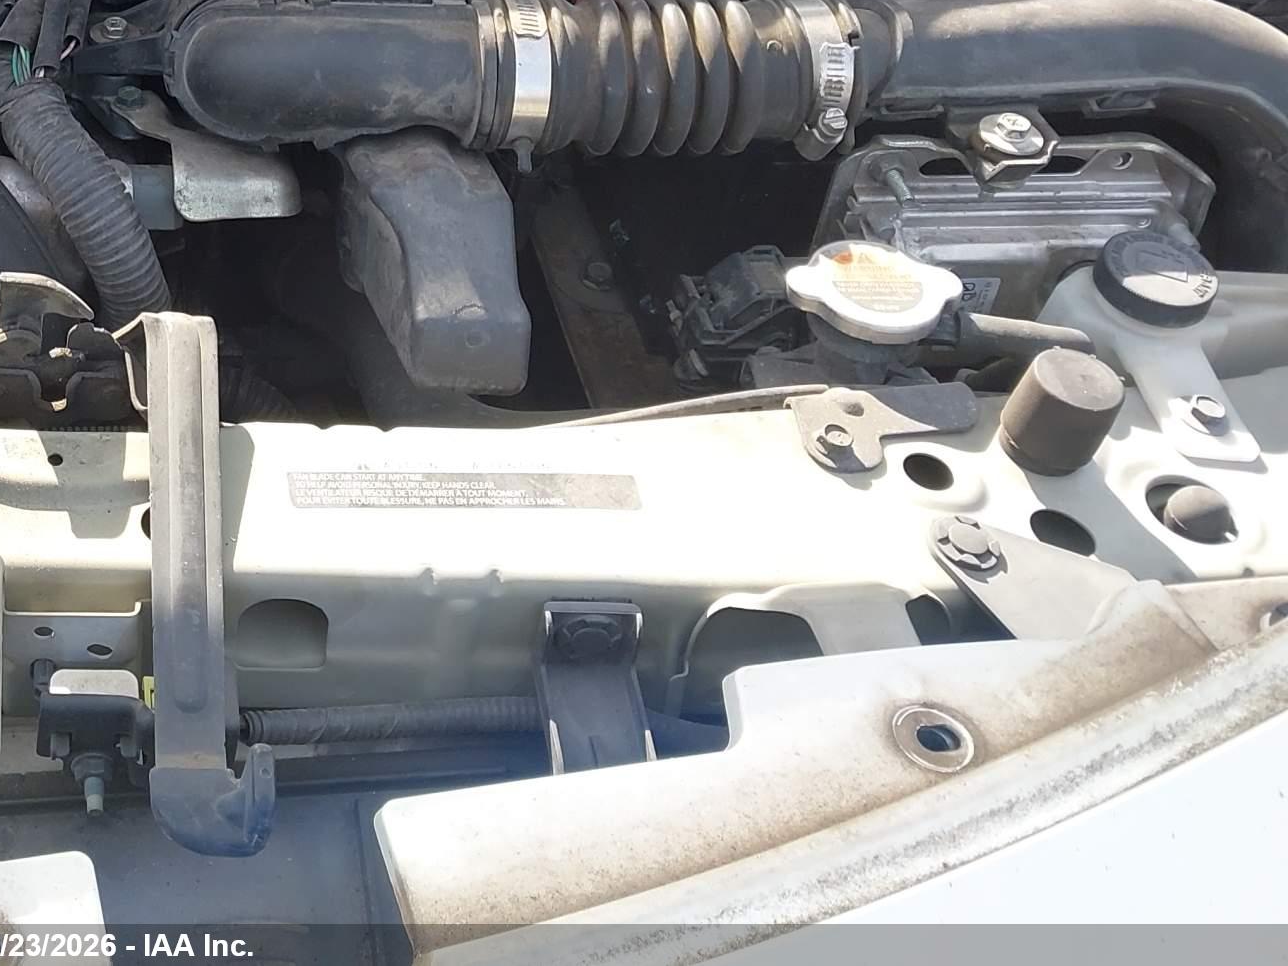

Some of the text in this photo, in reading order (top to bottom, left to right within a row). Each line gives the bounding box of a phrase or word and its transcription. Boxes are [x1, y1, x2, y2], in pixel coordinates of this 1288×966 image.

[442, 481, 470, 489] HANDS
[463, 489, 485, 497] TOUT
[297, 498, 320, 506] POUR
[438, 498, 454, 506] PAS
[468, 498, 519, 506] APPROCHER
[521, 498, 535, 506] LES
